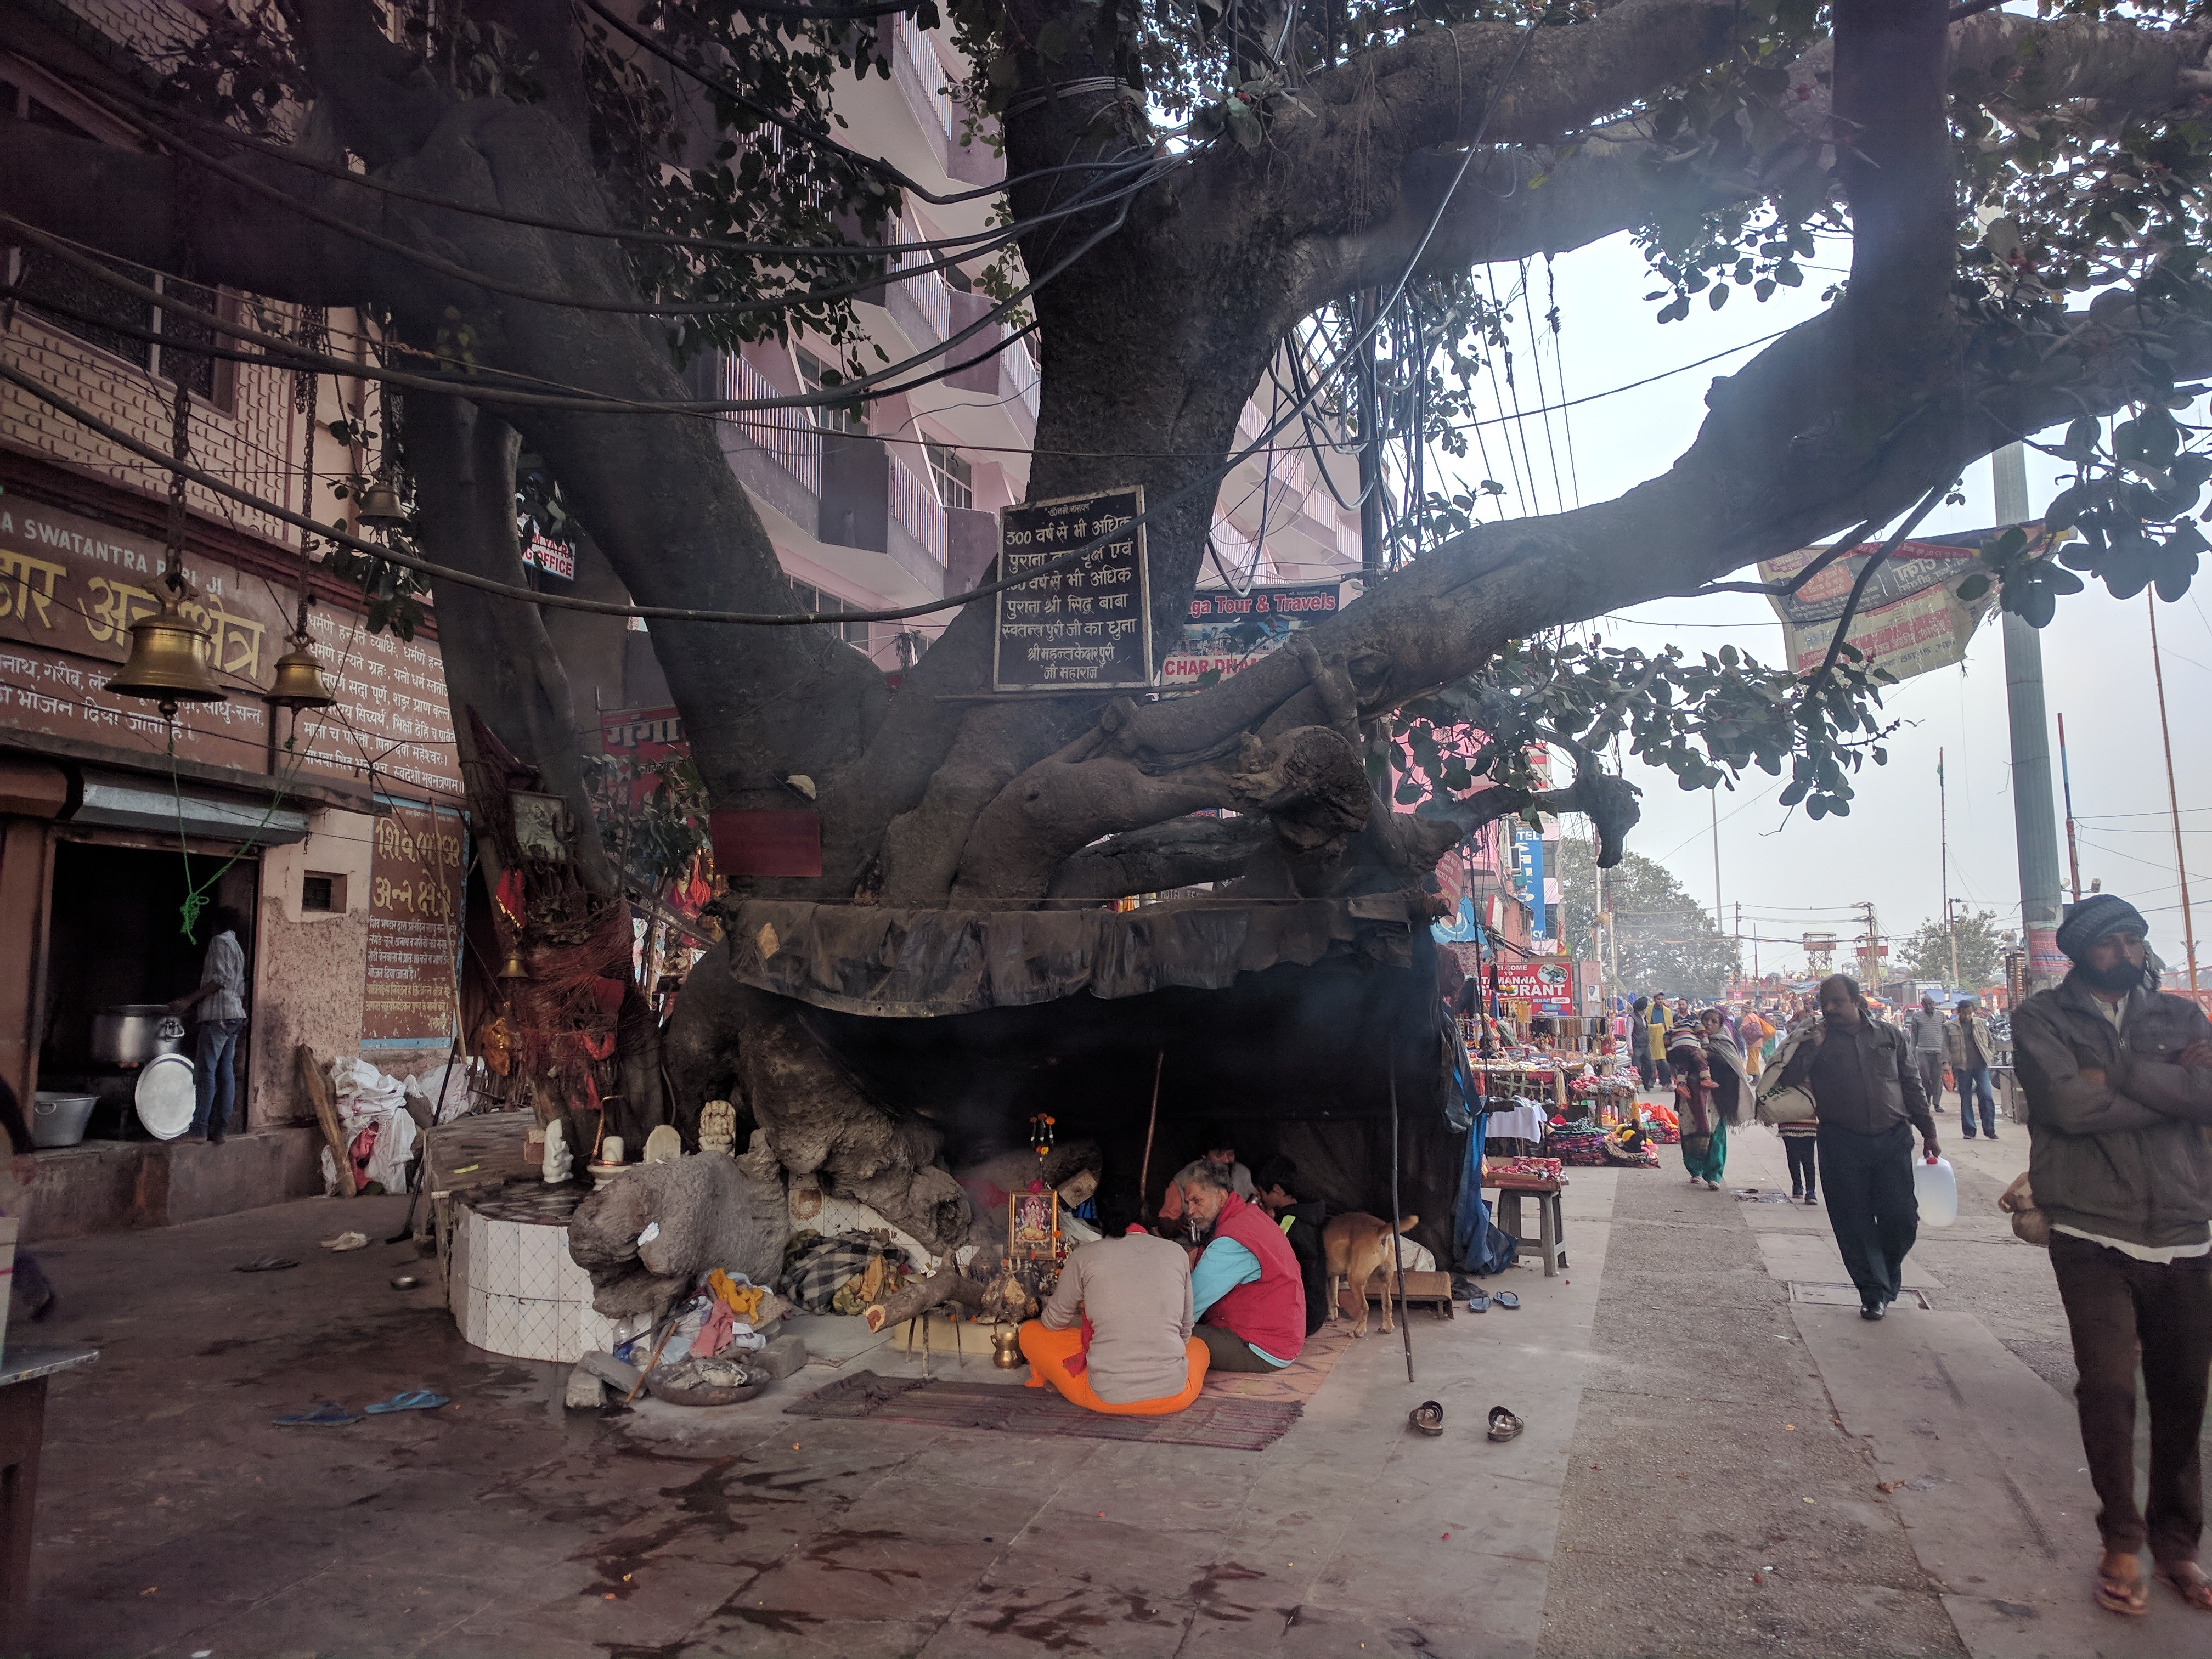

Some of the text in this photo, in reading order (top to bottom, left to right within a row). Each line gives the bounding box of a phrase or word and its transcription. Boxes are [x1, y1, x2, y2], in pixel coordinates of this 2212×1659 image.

[1006, 530, 1032, 545] 300
[1036, 522, 1054, 543] वर्ष
[1056, 521, 1069, 543] से
[1074, 518, 1087, 538] भी
[24, 519, 148, 573] SWATANTRA
[157, 560, 196, 586] PRI
[206, 577, 222, 595] JI
[1109, 537, 1135, 559] एवं
[1029, 573, 1050, 591] वर्ष
[1050, 569, 1063, 592] से
[1066, 568, 1085, 588] भी
[1090, 563, 1132, 587] अधिक
[1044, 594, 1062, 614] श्री
[1099, 592, 1129, 610] बाबा
[1215, 596, 1253, 614] Tour
[1255, 594, 1270, 613] &
[1274, 592, 1336, 613] Travels
[1046, 619, 1065, 642] पुरी
[1066, 618, 1082, 637] जी
[1084, 620, 1103, 636] का
[1027, 642, 1040, 662] श्री
[1041, 646, 1074, 663] महन्त
[1098, 641, 1116, 665] पुरी
[394, 667, 410, 685] यतो
[411, 672, 425, 690] धर्म
[1164, 659, 1209, 676] CHAR
[349, 679, 369, 701] सदा
[414, 698, 431, 716] प्राण
[18, 686, 73, 718] भोजन
[83, 696, 119, 727] दिया
[126, 712, 165, 734] जाता
[304, 721, 326, 740] माता
[330, 727, 340, 742] च
[1516, 831, 1540, 840] TEL
[1441, 862, 1454, 874] PHOTO
[373, 876, 415, 913] अन्न
[368, 964, 383, 978] भोजन
